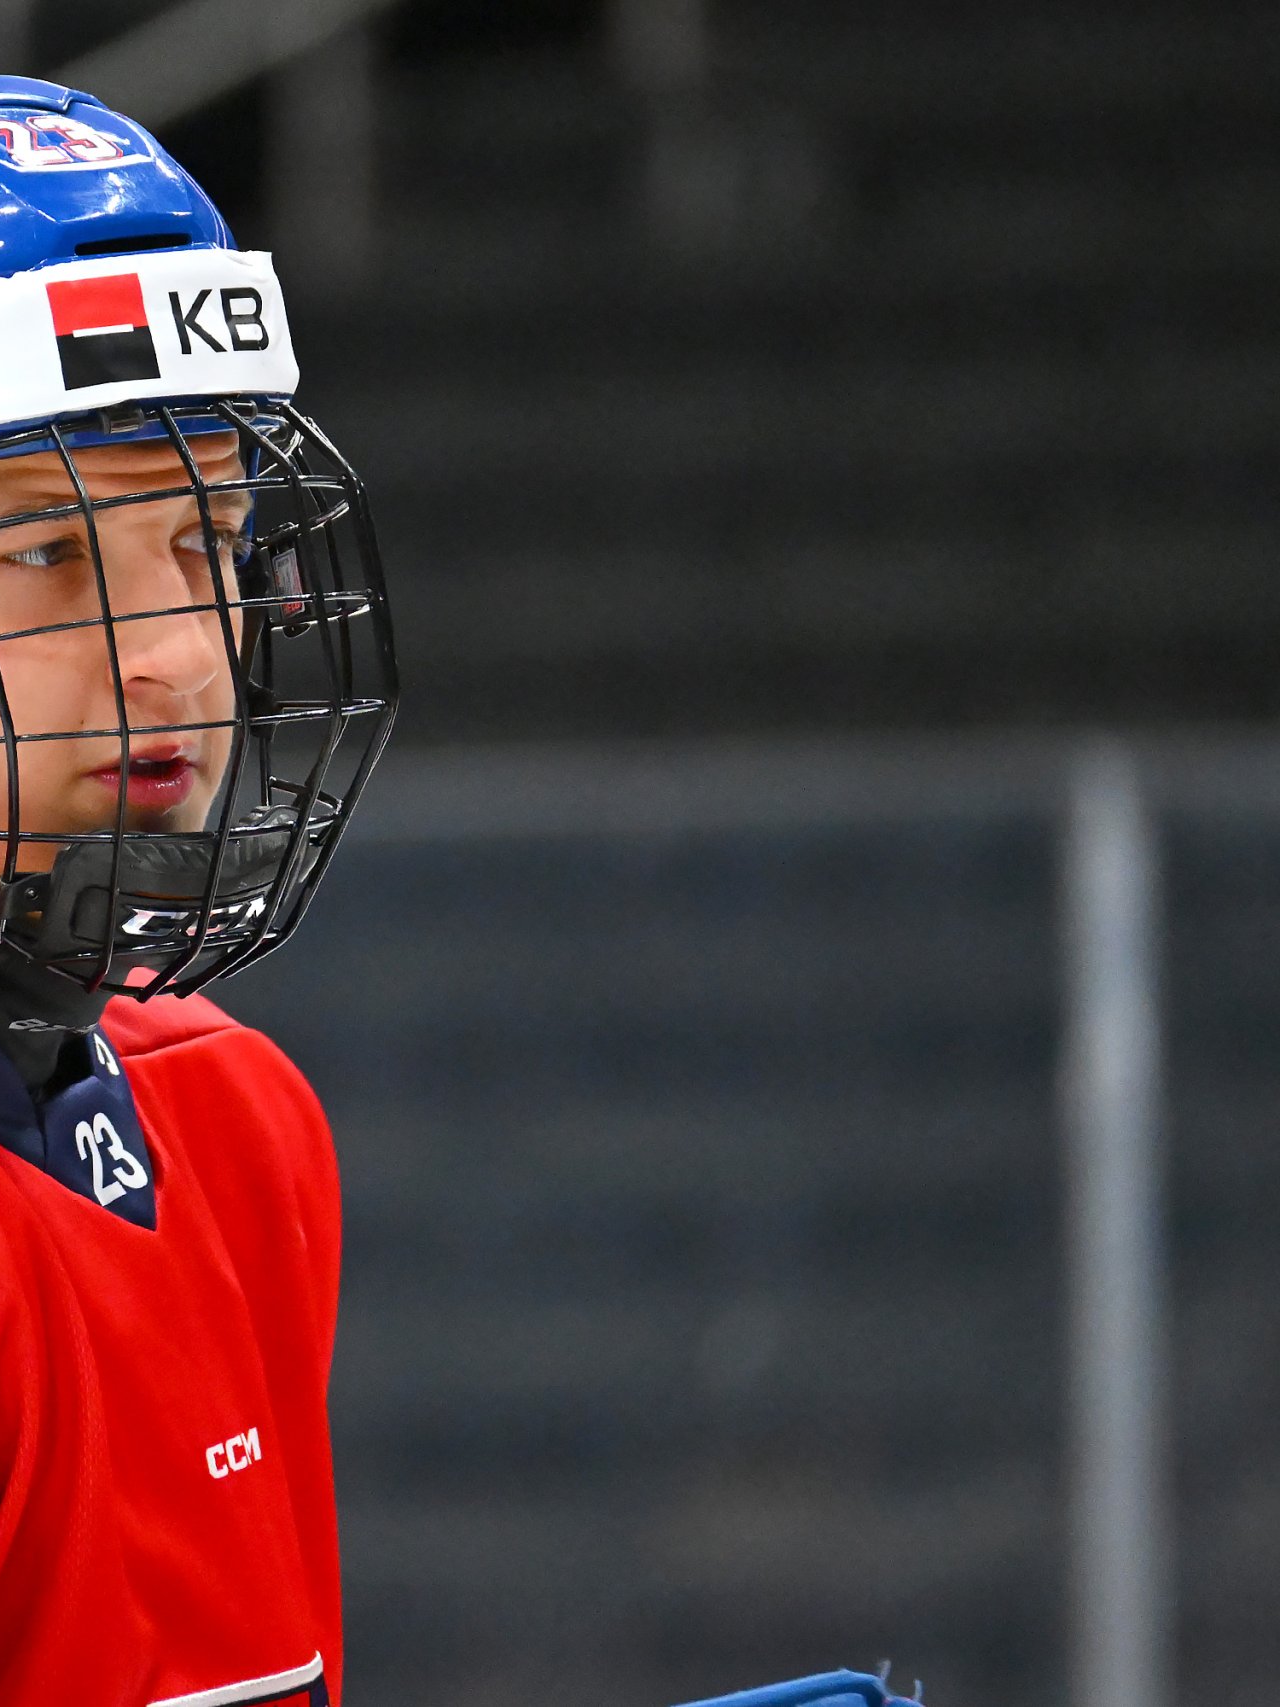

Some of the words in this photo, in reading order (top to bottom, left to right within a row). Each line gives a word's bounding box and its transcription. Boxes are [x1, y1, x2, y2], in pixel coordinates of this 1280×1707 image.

[168, 287, 269, 354] KB
[75, 1112, 148, 1206] 23
[205, 1426, 262, 1479] CCM
